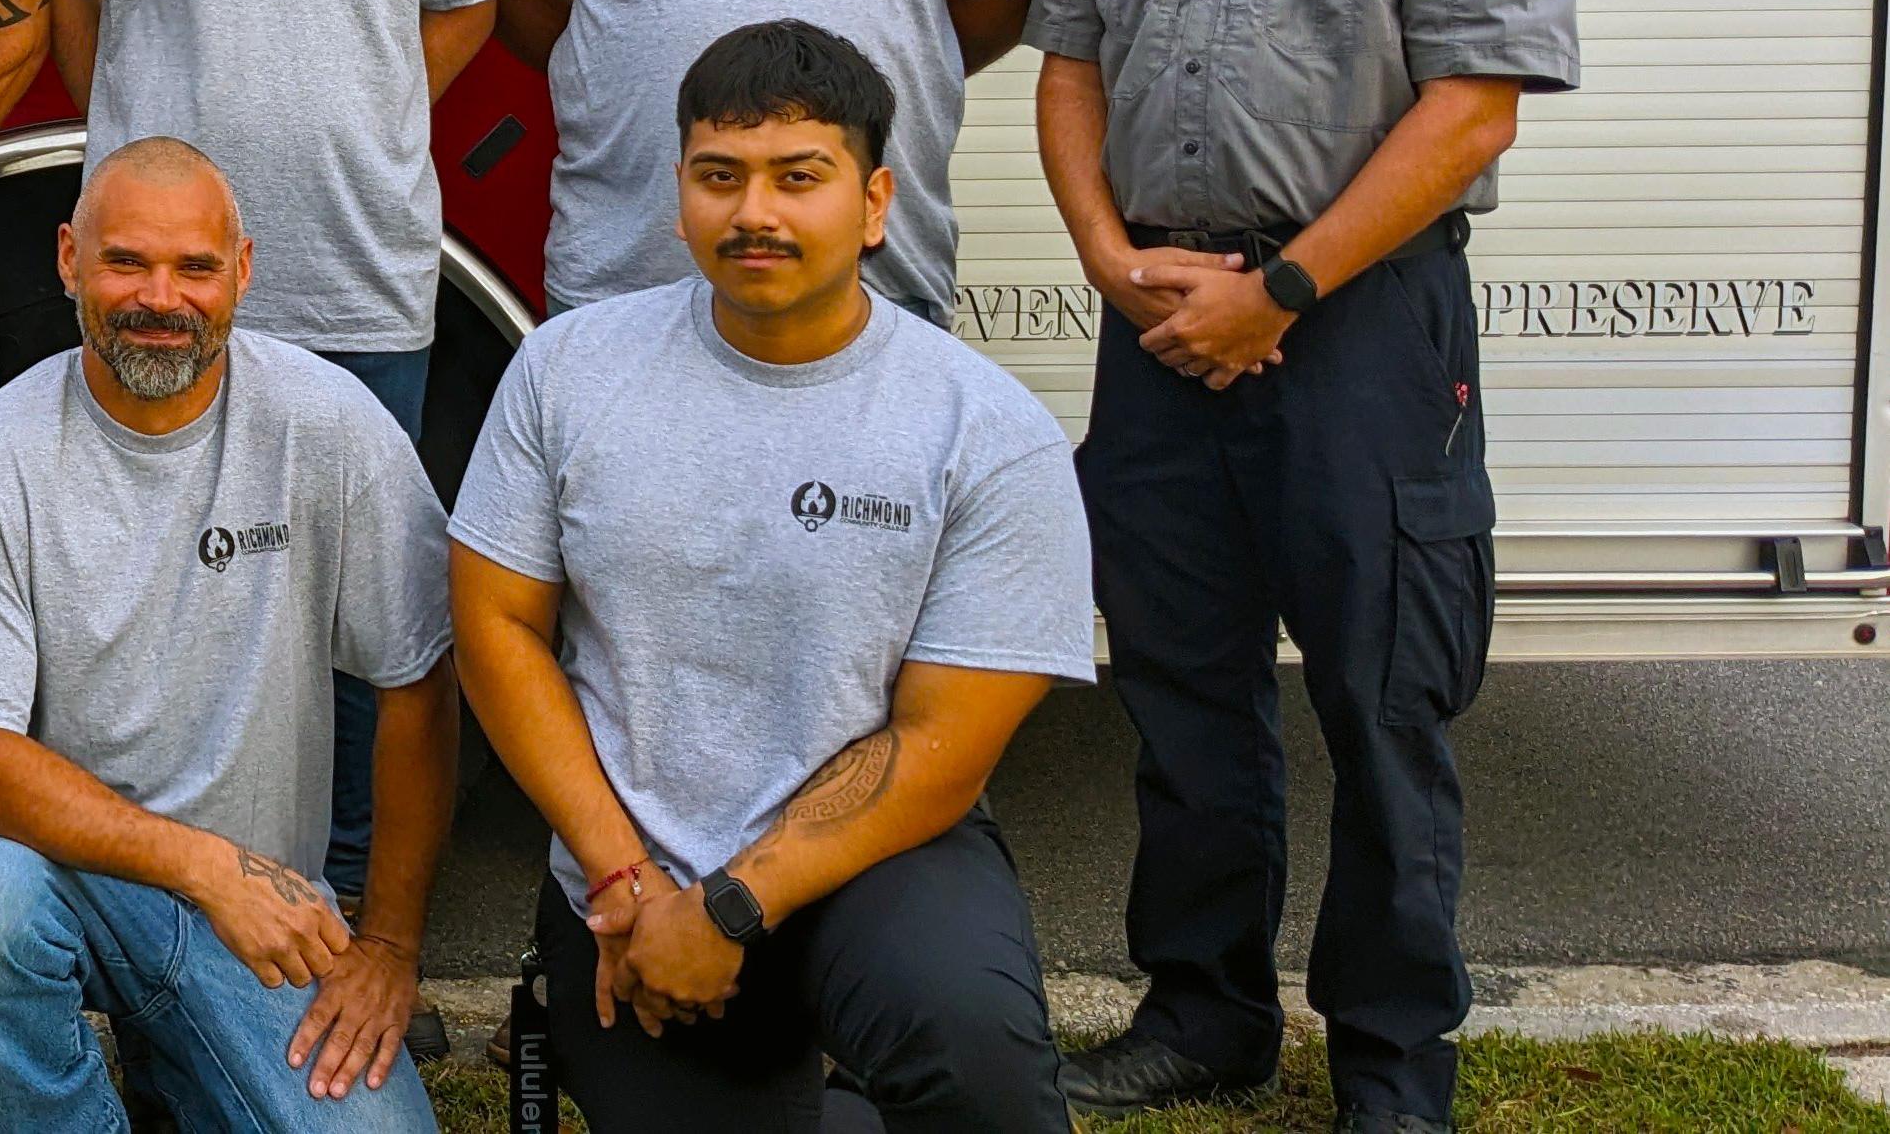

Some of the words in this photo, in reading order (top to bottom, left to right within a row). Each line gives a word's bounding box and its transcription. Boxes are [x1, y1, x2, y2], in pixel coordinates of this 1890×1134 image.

[1481, 280, 1815, 338] PRESERVE
[841, 496, 910, 526] RICHMOND
[237, 524, 289, 550] RICHMOND
